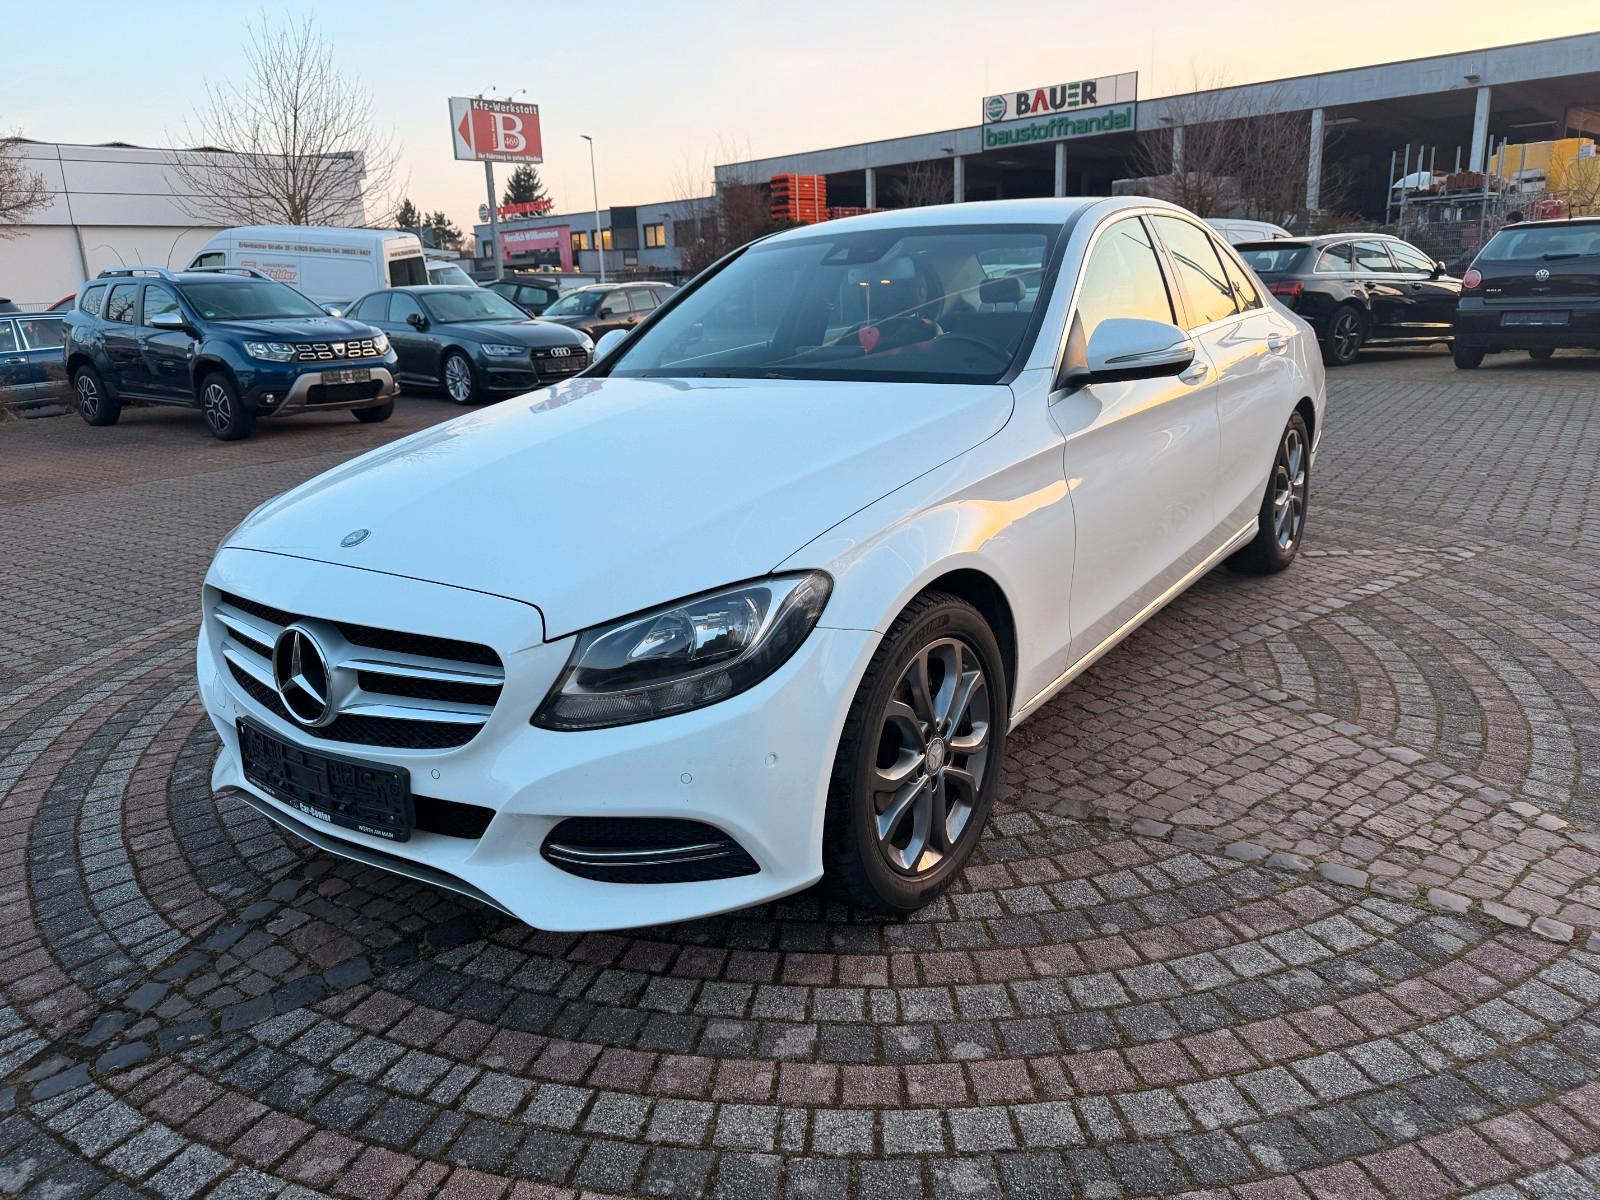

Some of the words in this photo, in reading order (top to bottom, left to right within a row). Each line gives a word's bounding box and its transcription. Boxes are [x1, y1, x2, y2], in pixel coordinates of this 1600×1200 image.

[473, 100, 537, 114] Kfz-Werkstatt
[1016, 81, 1098, 115] BAUER
[489, 113, 526, 152] B
[985, 107, 1132, 147] baustoffhandel
